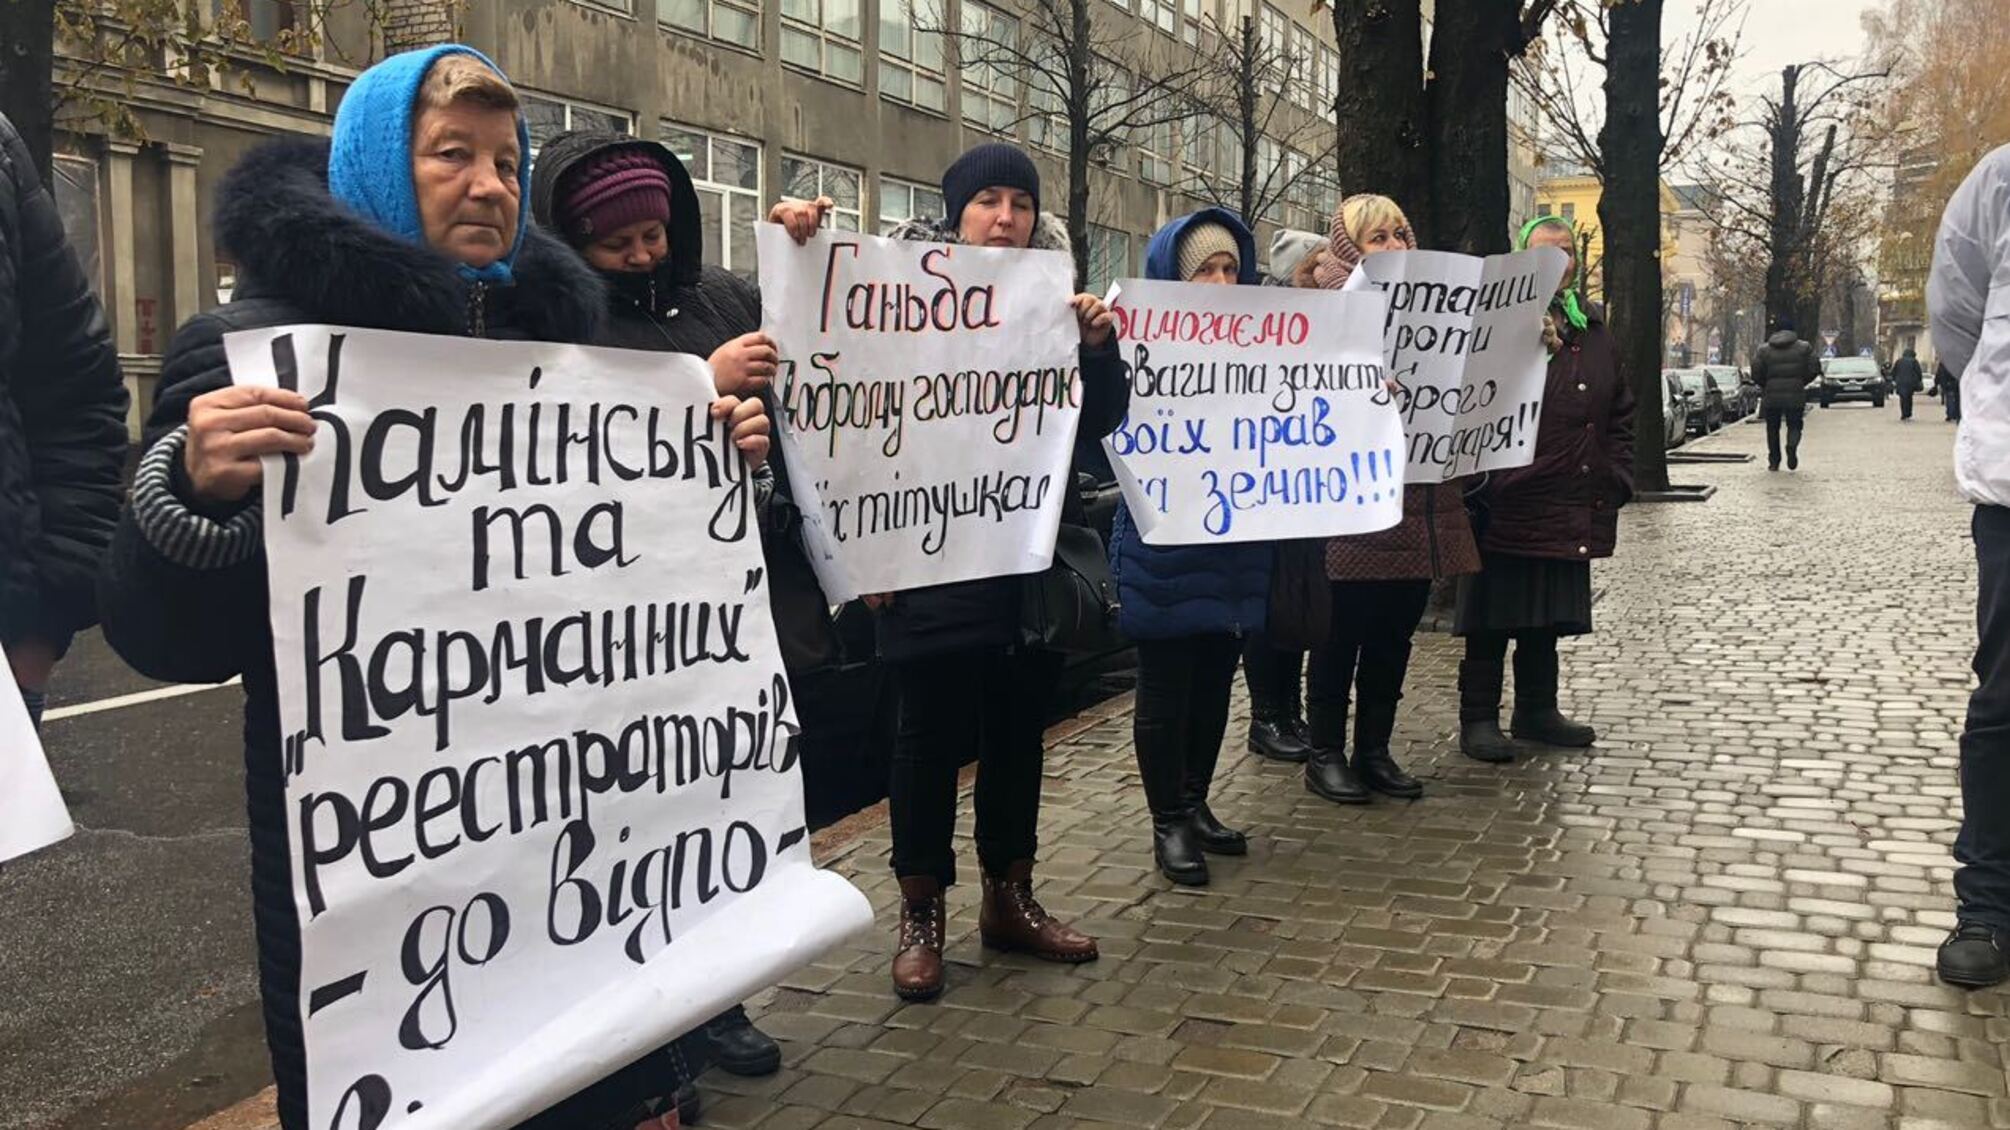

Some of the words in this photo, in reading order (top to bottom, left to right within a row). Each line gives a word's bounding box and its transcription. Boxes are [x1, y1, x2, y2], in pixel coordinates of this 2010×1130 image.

[820, 242, 1001, 333] Ганьба
[1225, 362, 1267, 395] та
[1384, 324, 1493, 369] роти
[271, 332, 748, 542] Камінську
[1233, 397, 1337, 468] прав
[1404, 401, 1540, 480] подаря!!
[1201, 449, 1396, 536] землю!!!
[472, 500, 640, 590] та
[300, 672, 802, 919] реестраторів
[399, 892, 510, 1050] до
[546, 819, 806, 964] відпо-
